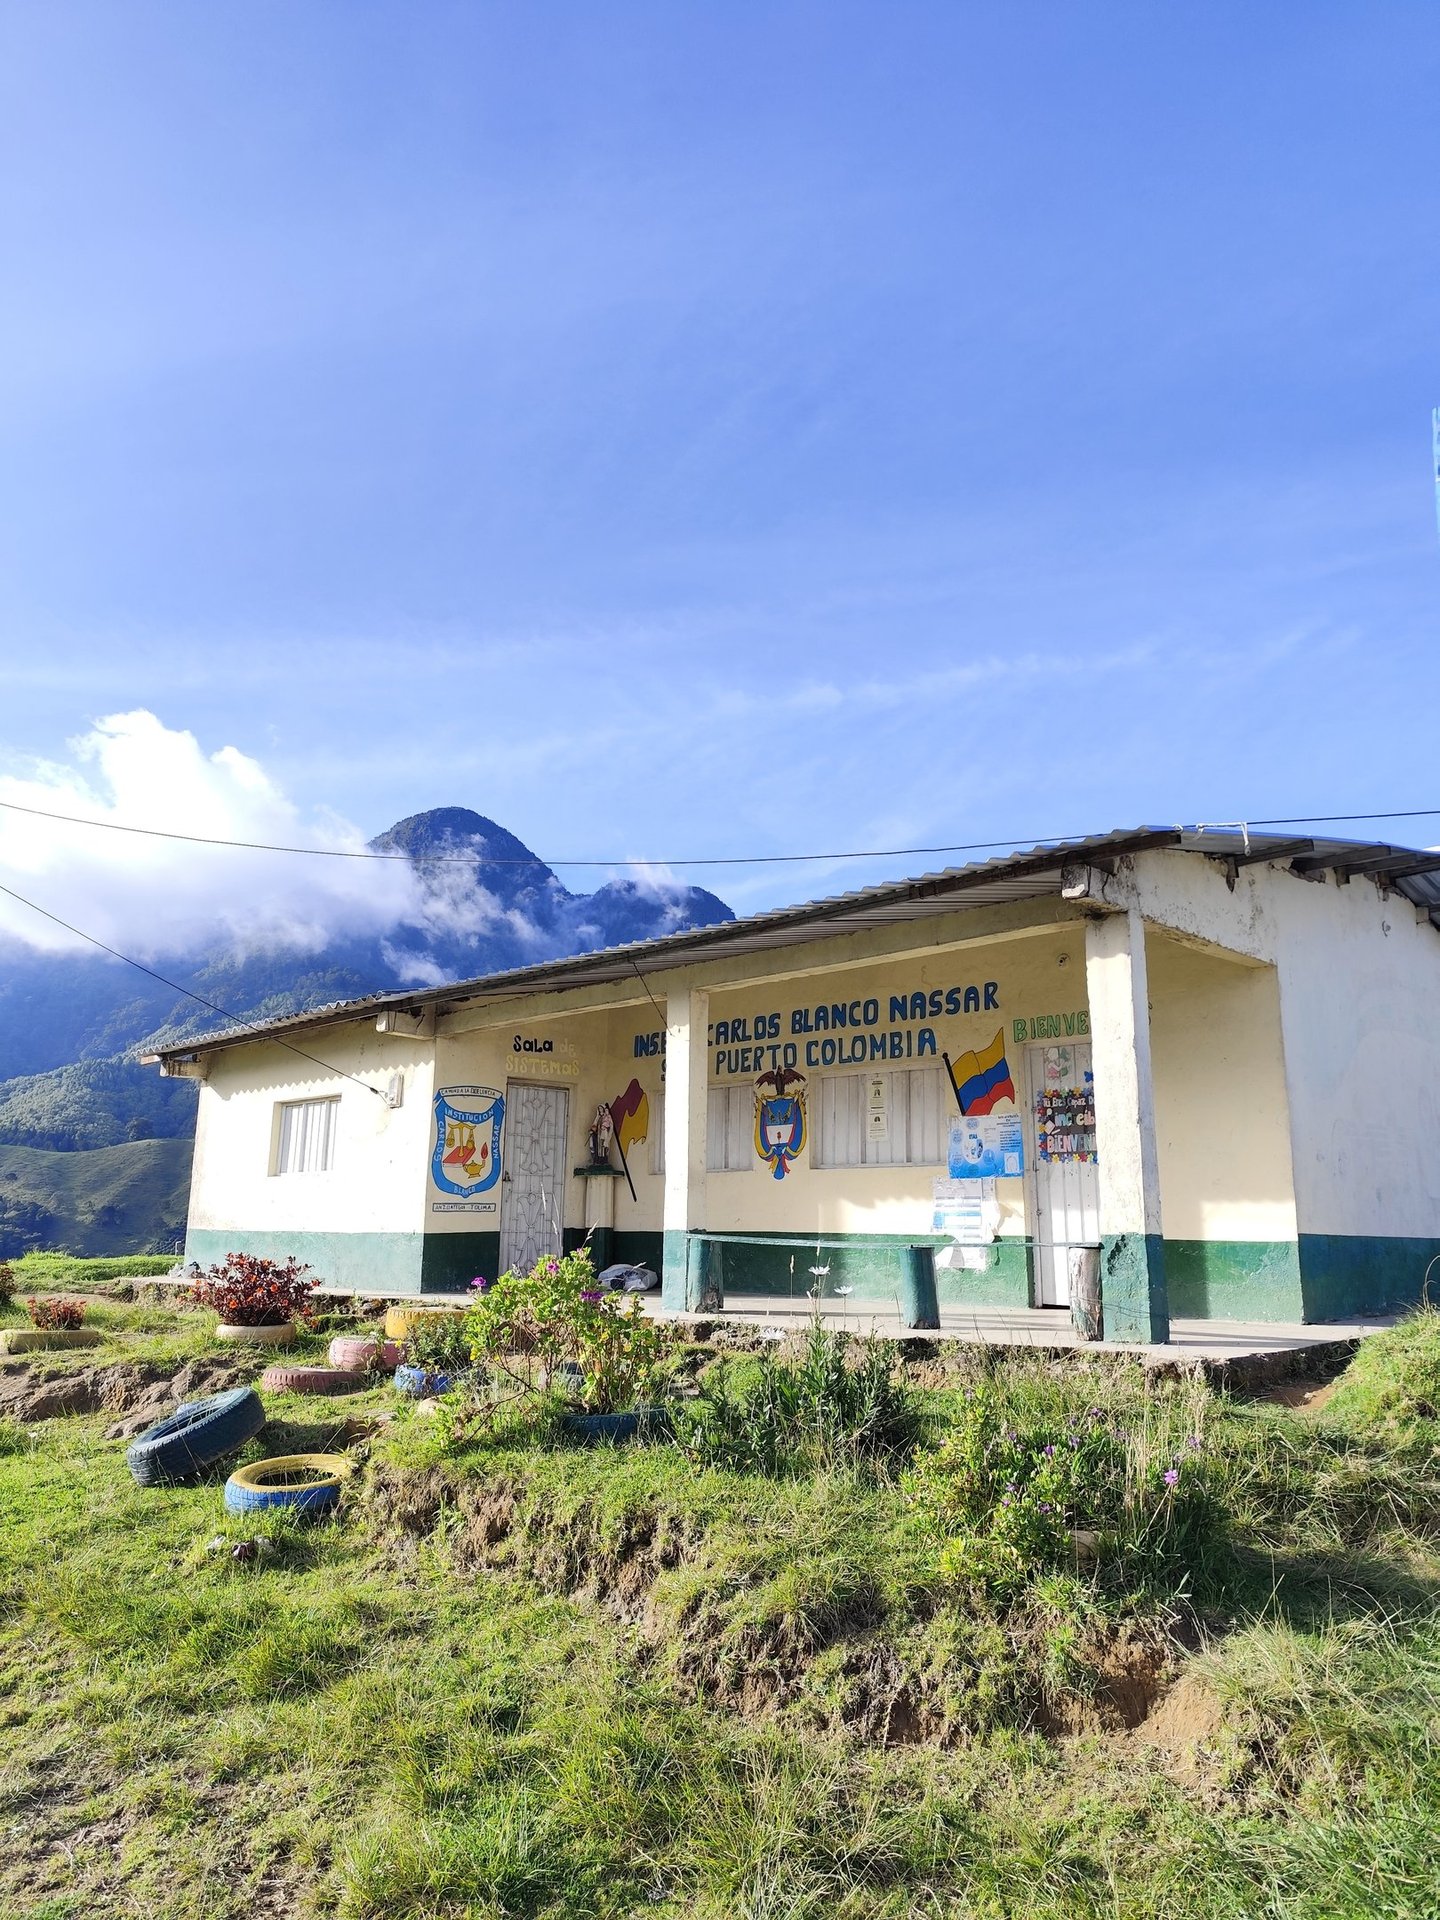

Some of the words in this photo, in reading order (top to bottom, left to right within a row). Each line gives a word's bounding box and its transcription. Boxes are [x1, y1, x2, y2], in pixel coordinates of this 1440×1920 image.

[791, 998, 879, 1035] BLANCO
[889, 981, 1000, 1024] NASSAR
[1013, 1010, 1090, 1044] BIENVE
[715, 1042, 797, 1075] PUERTO
[806, 1027, 937, 1067] COLOMBIA
[444, 1107, 494, 1121] INSTITUCION
[434, 1120, 445, 1161] CARLOS
[493, 1124, 501, 1159] NASSAR
